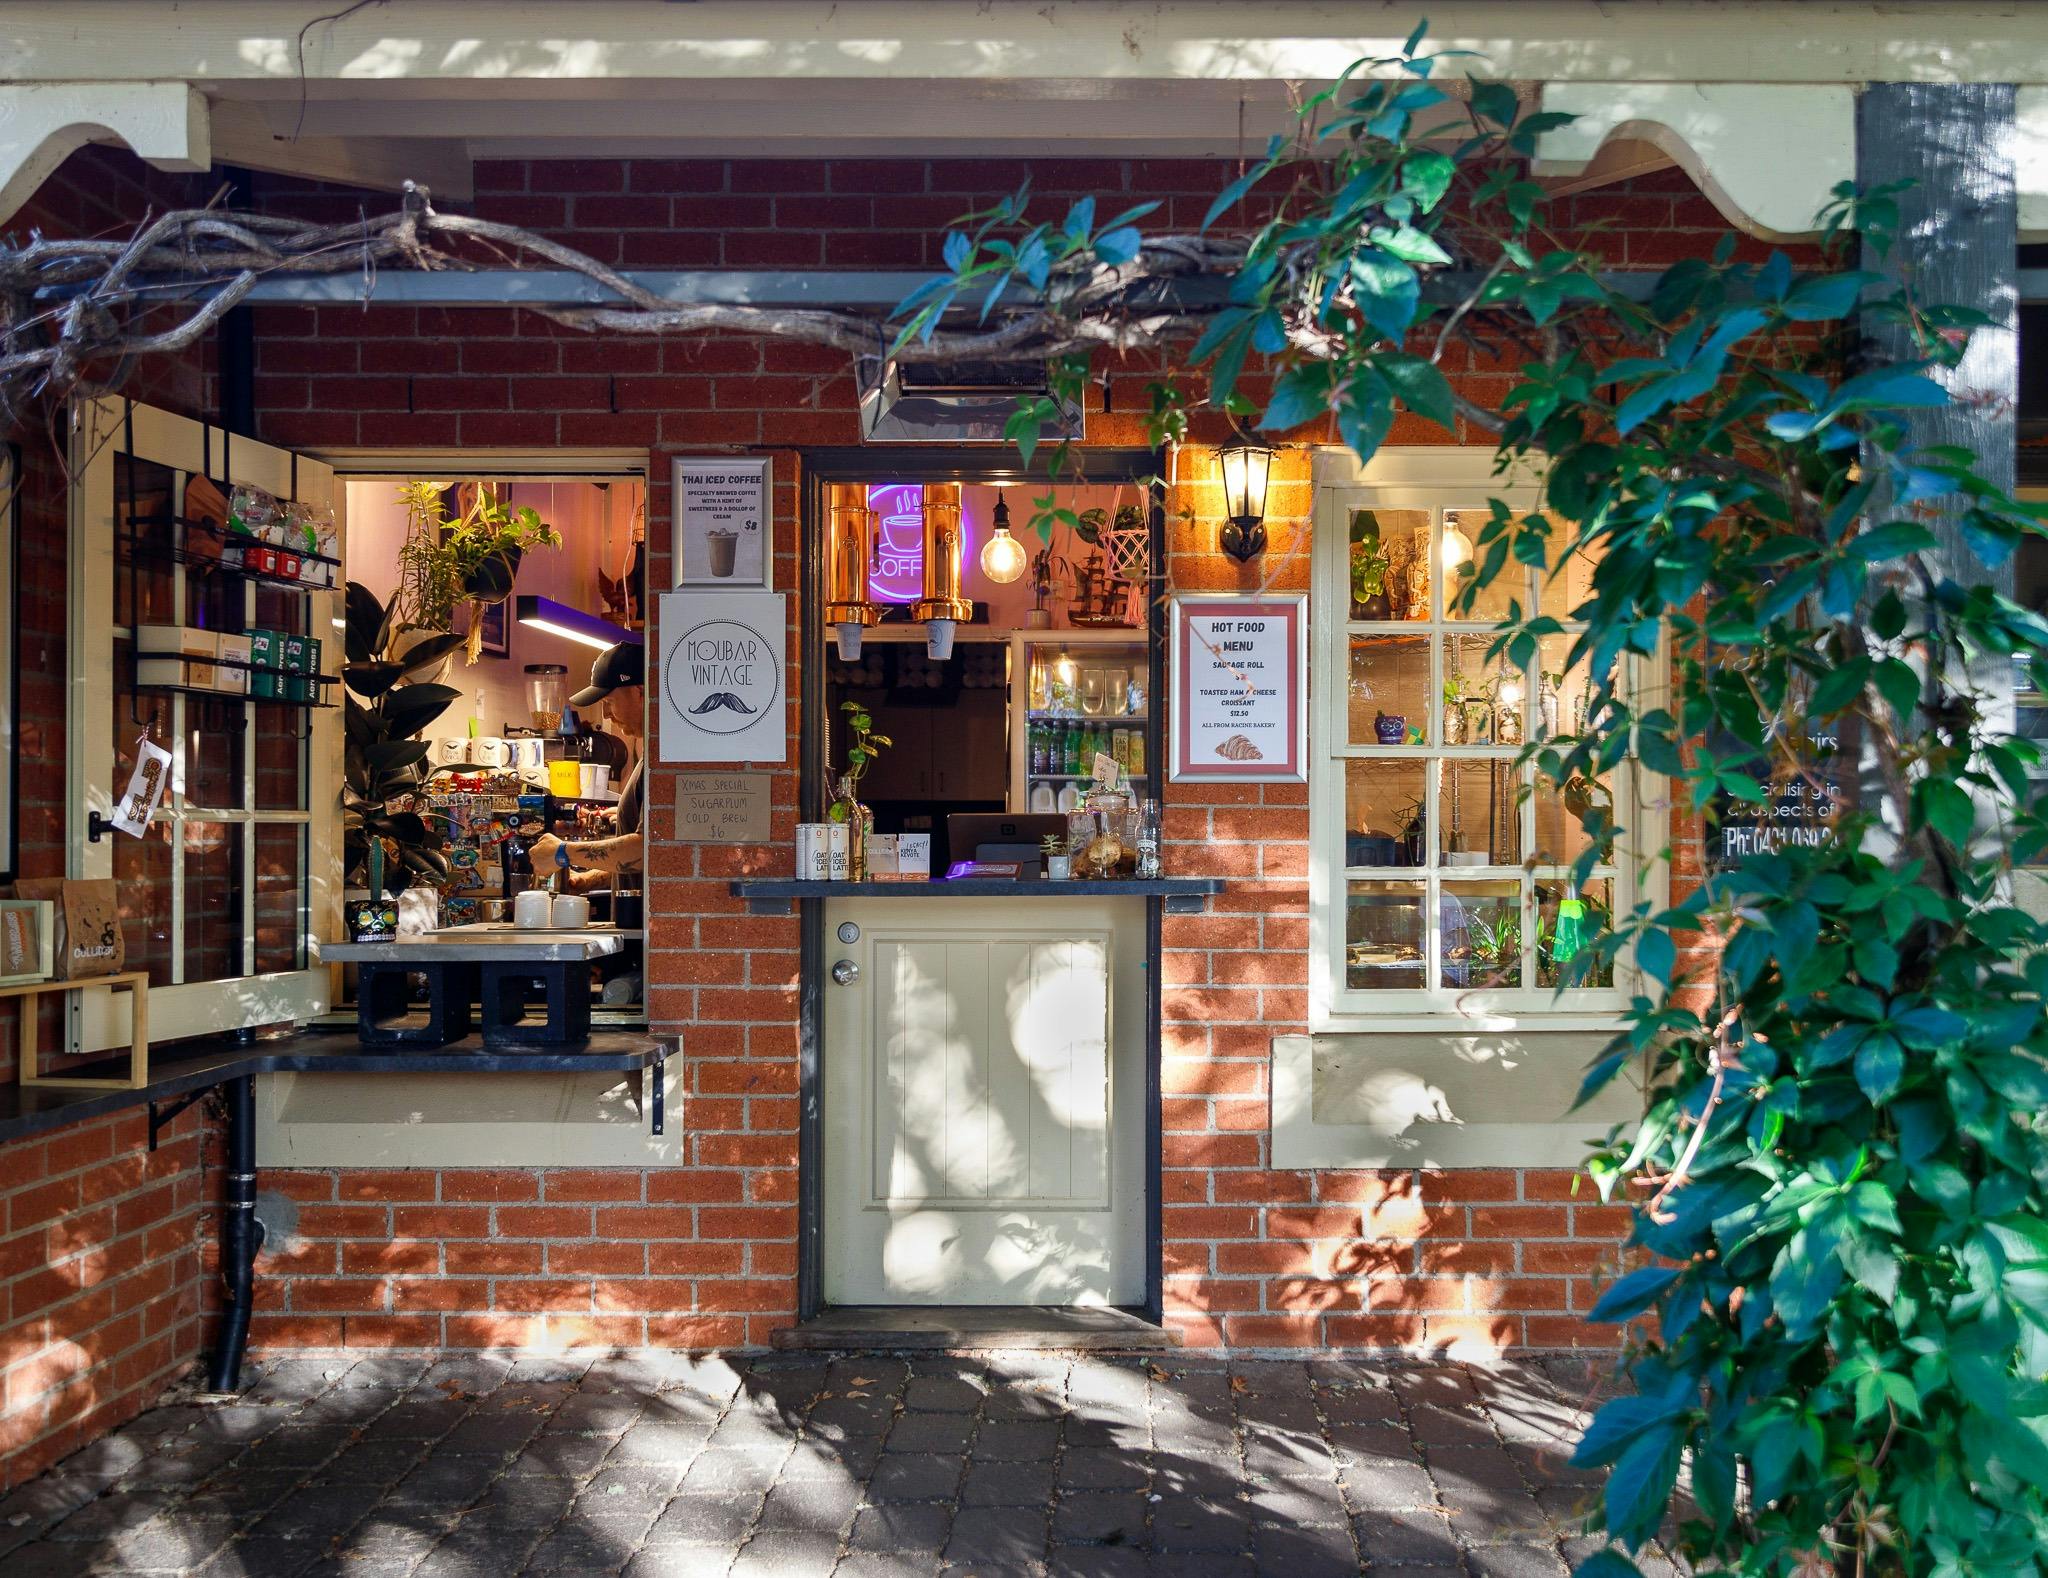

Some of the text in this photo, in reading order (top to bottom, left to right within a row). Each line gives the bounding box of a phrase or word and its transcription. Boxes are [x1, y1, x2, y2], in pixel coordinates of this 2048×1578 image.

[682, 475, 762, 484] THAI ICED COFFEE
[744, 519, 758, 531] $8
[869, 559, 922, 576] COFF
[1211, 622, 1265, 633] HOT FOOD
[687, 640, 757, 661] MOUBAR
[1223, 641, 1254, 652] MENU
[277, 640, 285, 695] AerPress
[1246, 661, 1264, 669] ROLL
[691, 664, 753, 686] VINTAGE
[681, 779, 749, 791] XMAS SPECIAL
[691, 797, 747, 809] SUGARPLUM
[686, 812, 748, 824] COLD BREW
[710, 824, 725, 839] $6
[1727, 827, 1750, 857] Ph:
